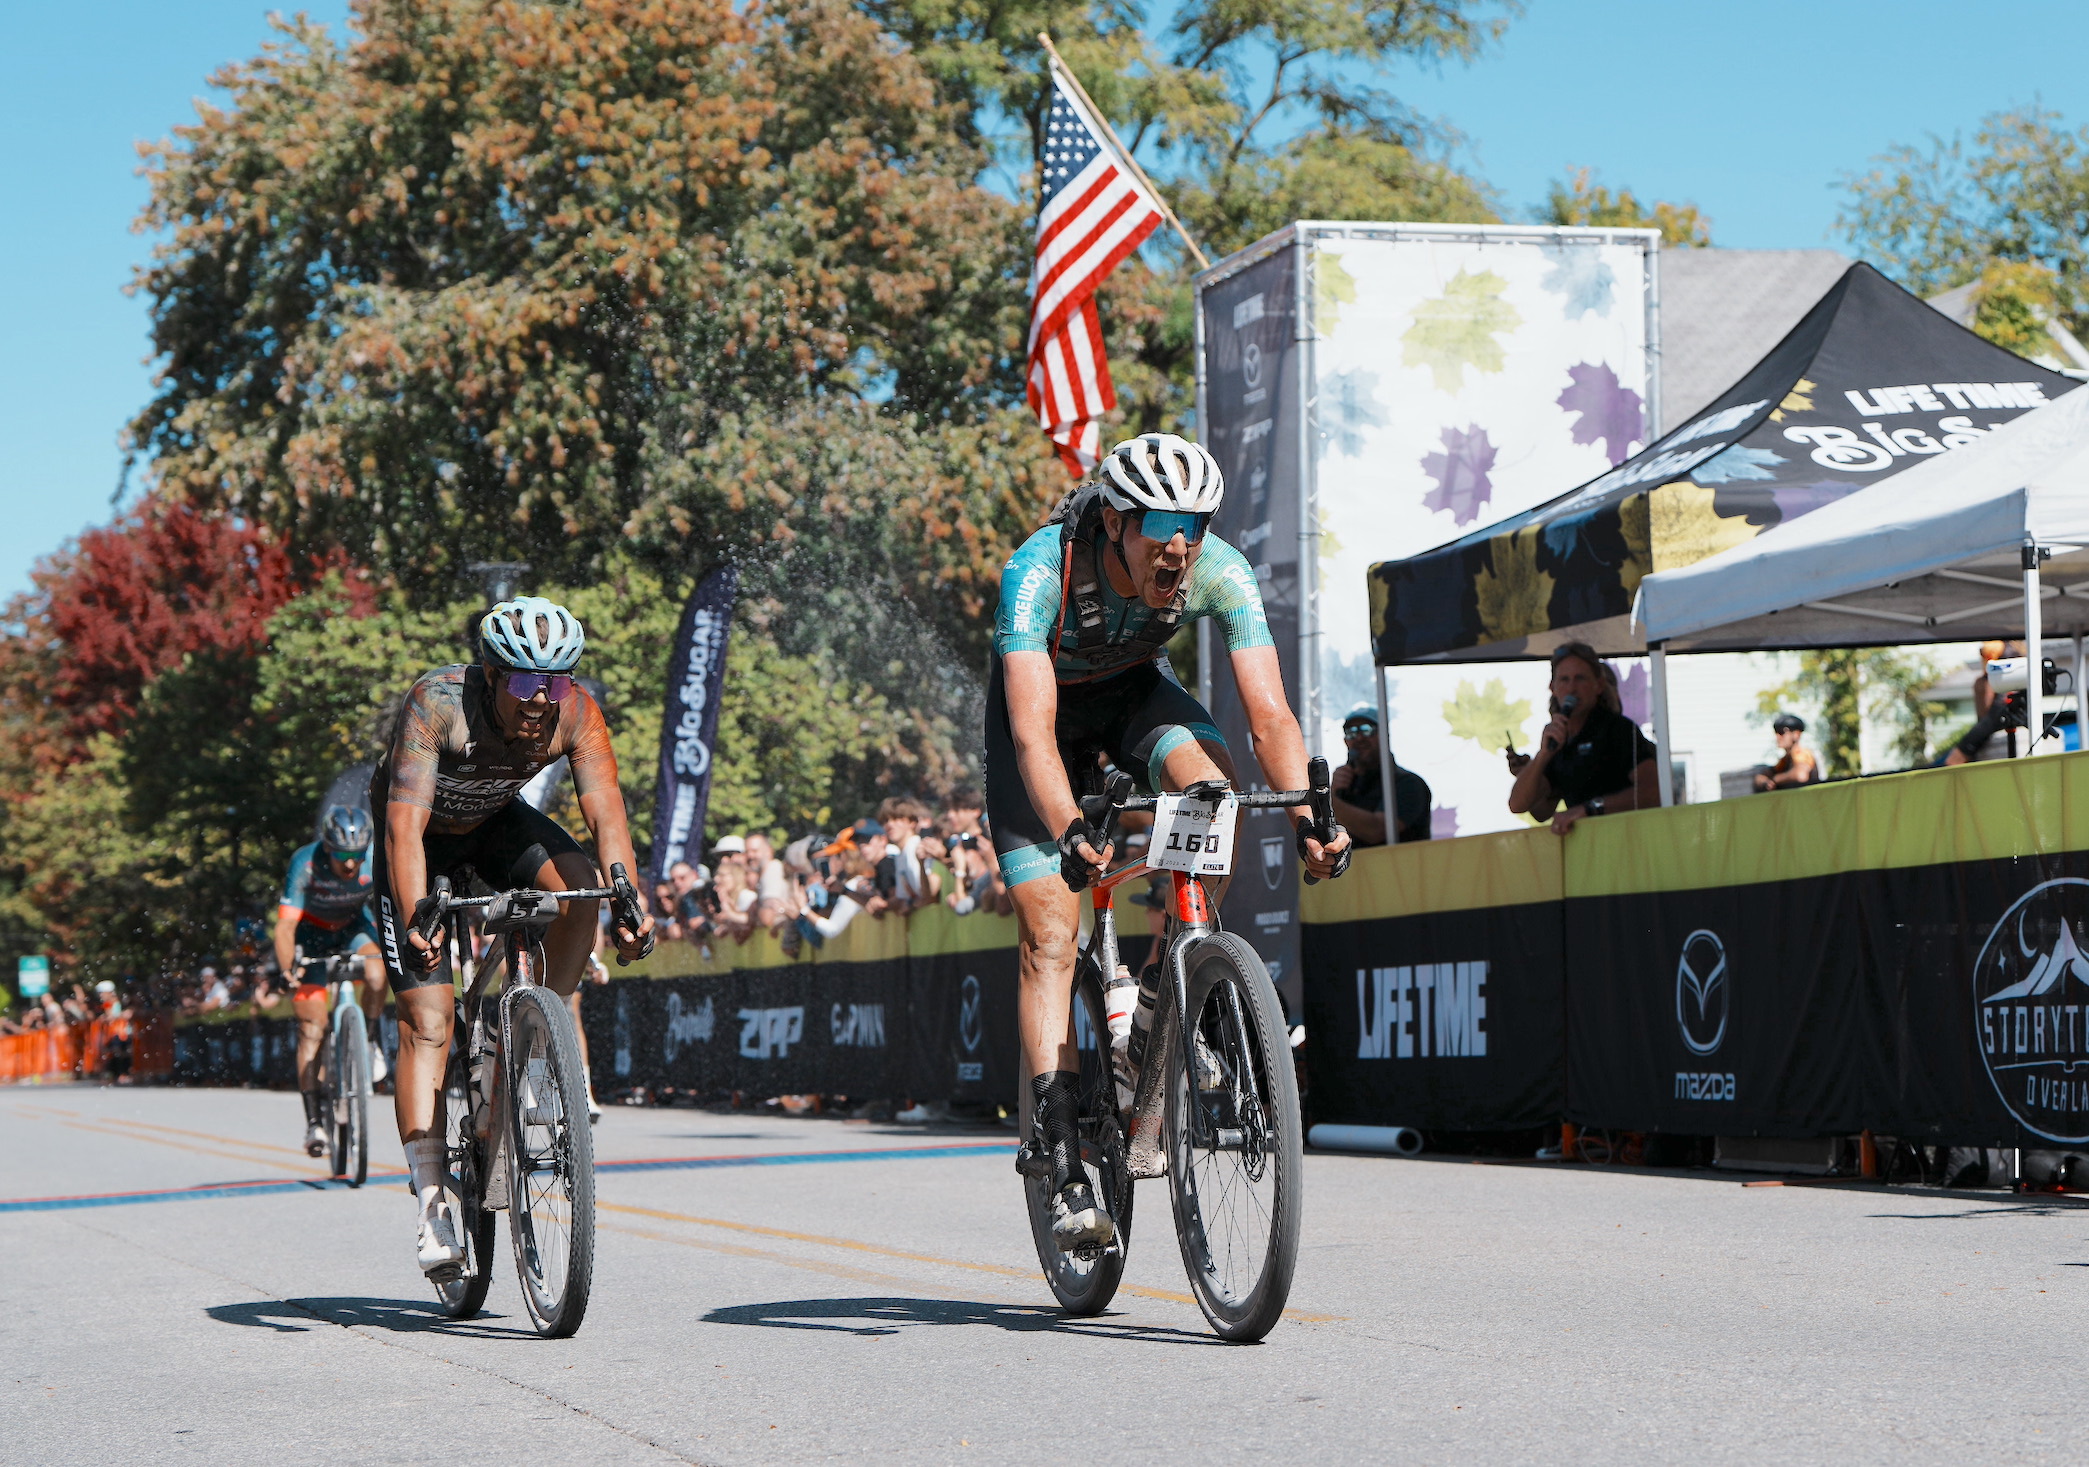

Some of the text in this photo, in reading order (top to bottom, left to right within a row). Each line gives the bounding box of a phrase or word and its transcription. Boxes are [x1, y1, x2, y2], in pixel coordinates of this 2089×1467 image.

[1223, 564, 1267, 623] GIANT
[1166, 832, 1220, 853] 160
[381, 895, 403, 976] GIANT
[738, 1006, 805, 1059] ZIPP
[1983, 1004, 2089, 1054] STORYT
